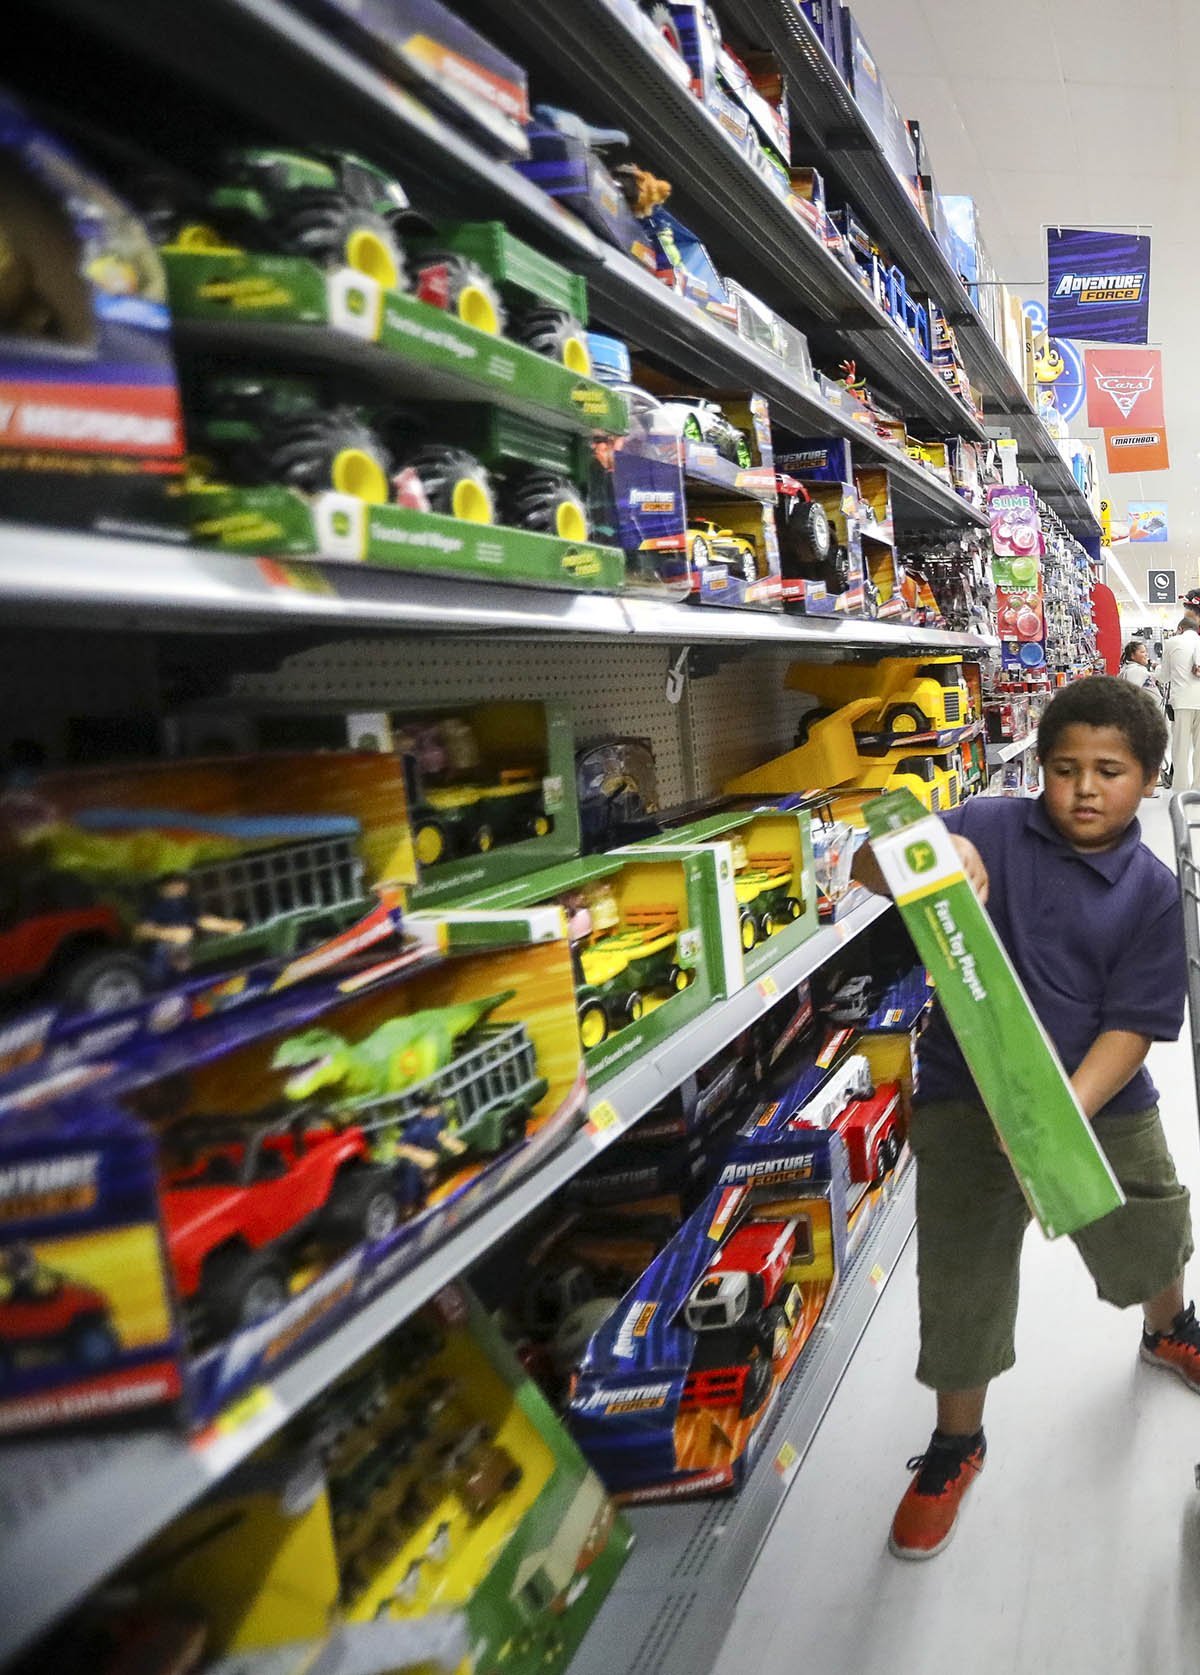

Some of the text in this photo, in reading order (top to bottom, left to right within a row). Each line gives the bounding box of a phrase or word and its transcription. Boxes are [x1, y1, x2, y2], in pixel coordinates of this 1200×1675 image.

[1055, 274, 1145, 295] ADVENTURE
[1086, 290, 1134, 300] FORCE
[1102, 379, 1144, 391] Cars
[1115, 436, 1155, 445] MATCHBOX
[993, 497, 1030, 510] SLIME
[934, 899, 957, 935] Farm
[949, 931, 967, 957] Toy
[958, 953, 987, 1002] Playset
[718, 1152, 815, 1185] ADVENTURE
[751, 1170, 806, 1185] FORCE
[582, 1382, 673, 1411] ADVENTURE
